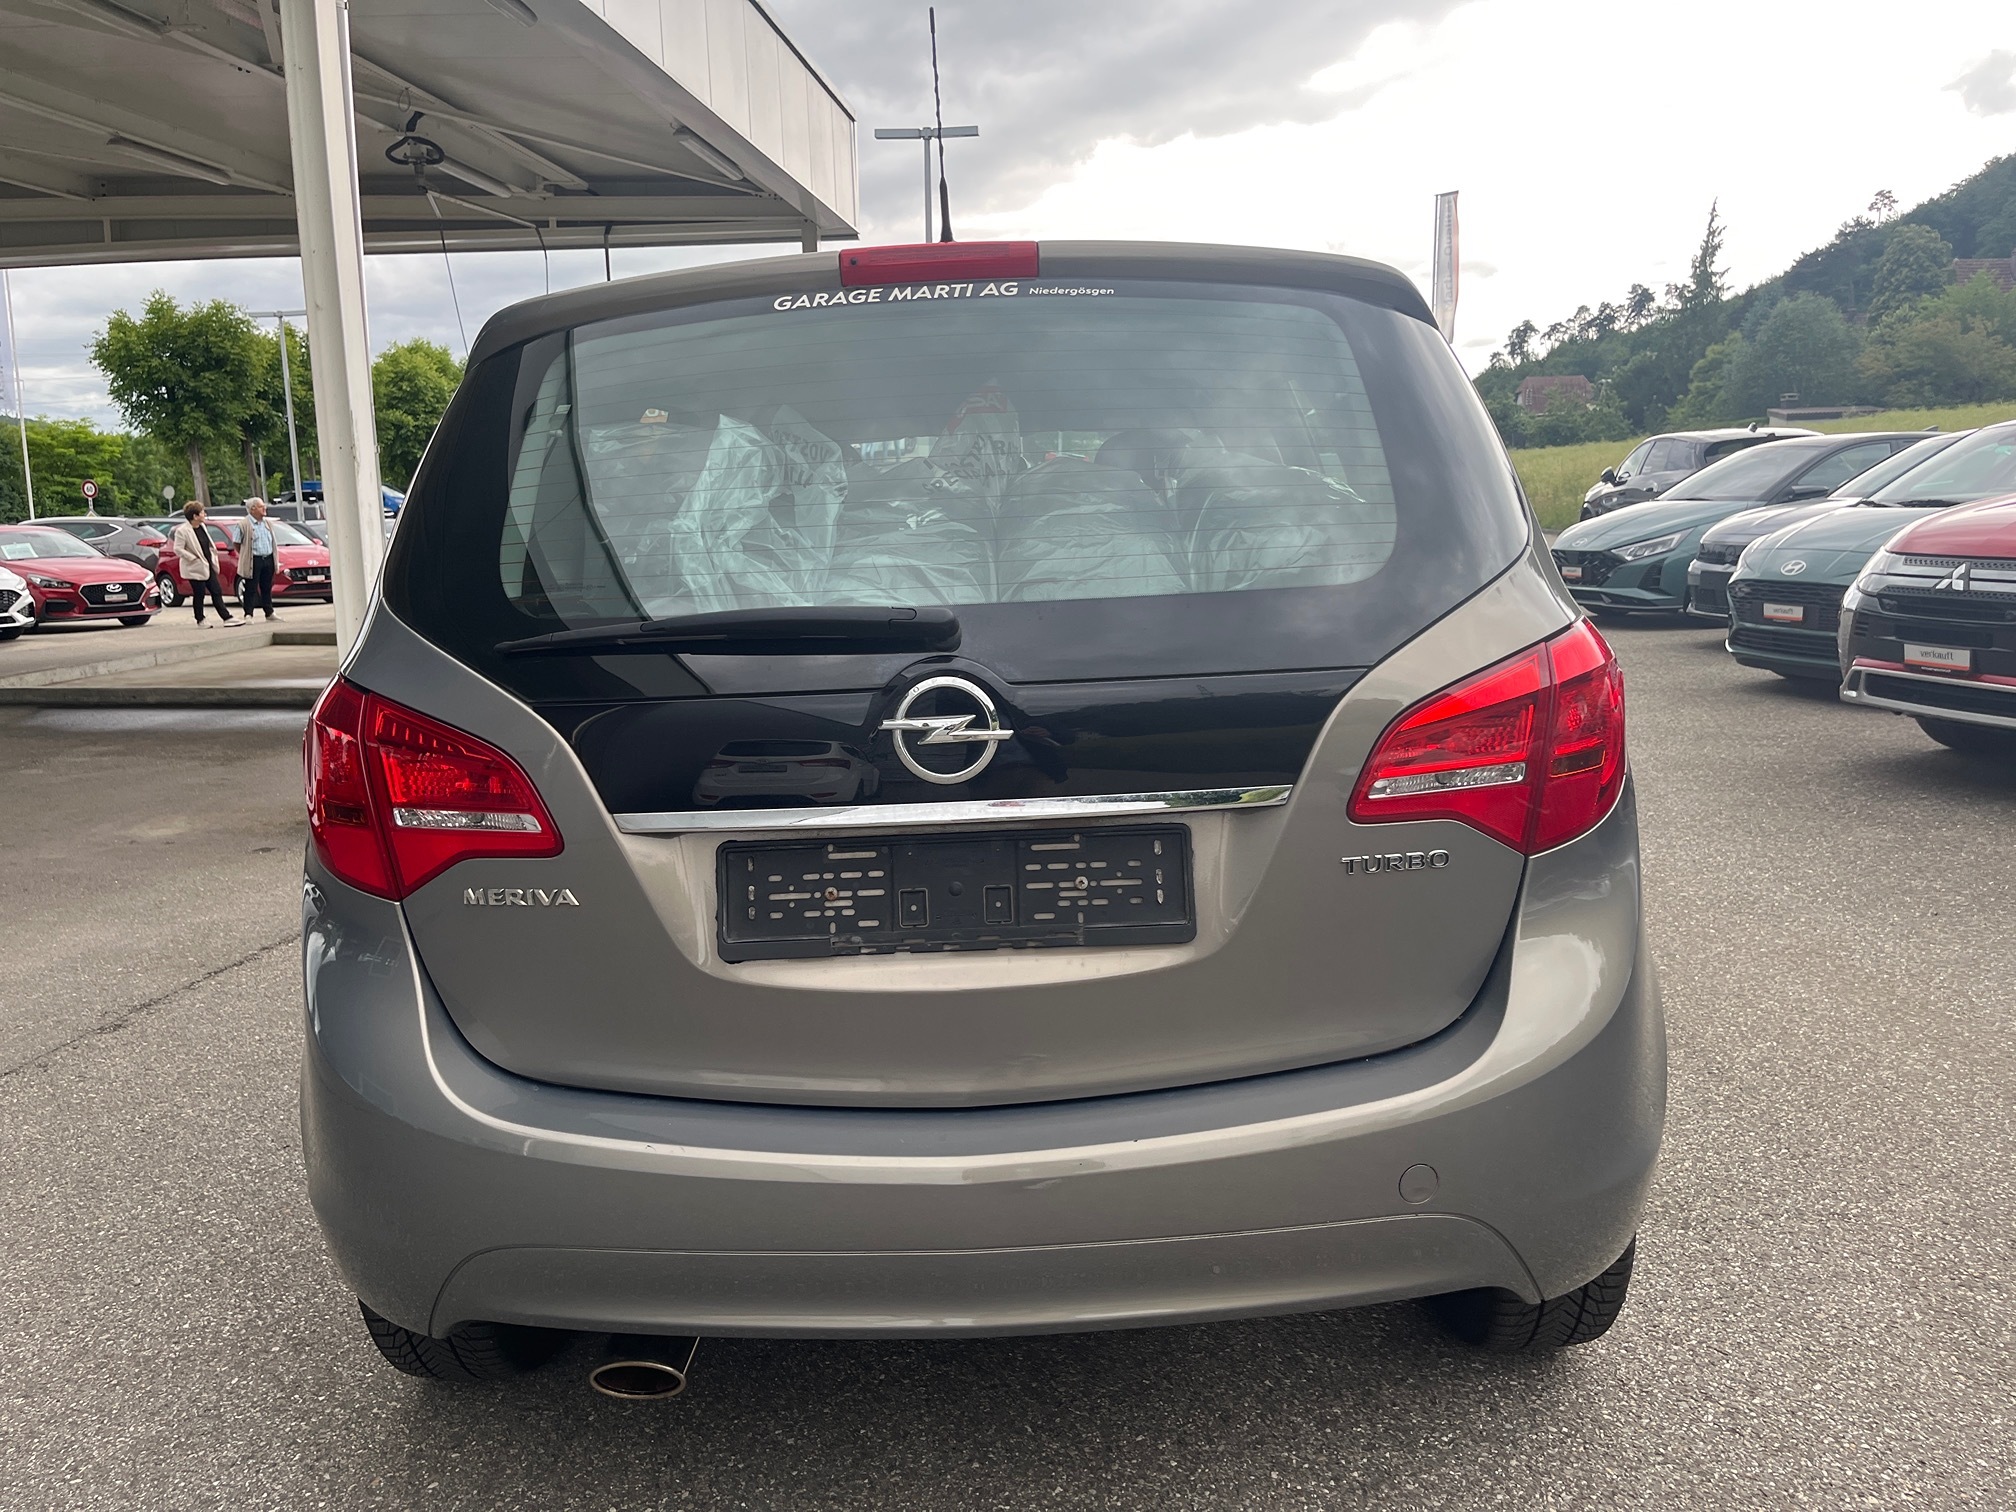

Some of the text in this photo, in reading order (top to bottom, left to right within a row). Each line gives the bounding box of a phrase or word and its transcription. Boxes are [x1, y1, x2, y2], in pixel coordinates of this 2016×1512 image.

[773, 282, 1114, 311] GARAGE MARTI AG Niedergösgen
[1919, 650, 1954, 661] verkauft
[1341, 849, 1450, 875] TURBO
[463, 887, 580, 906] MERIVA
